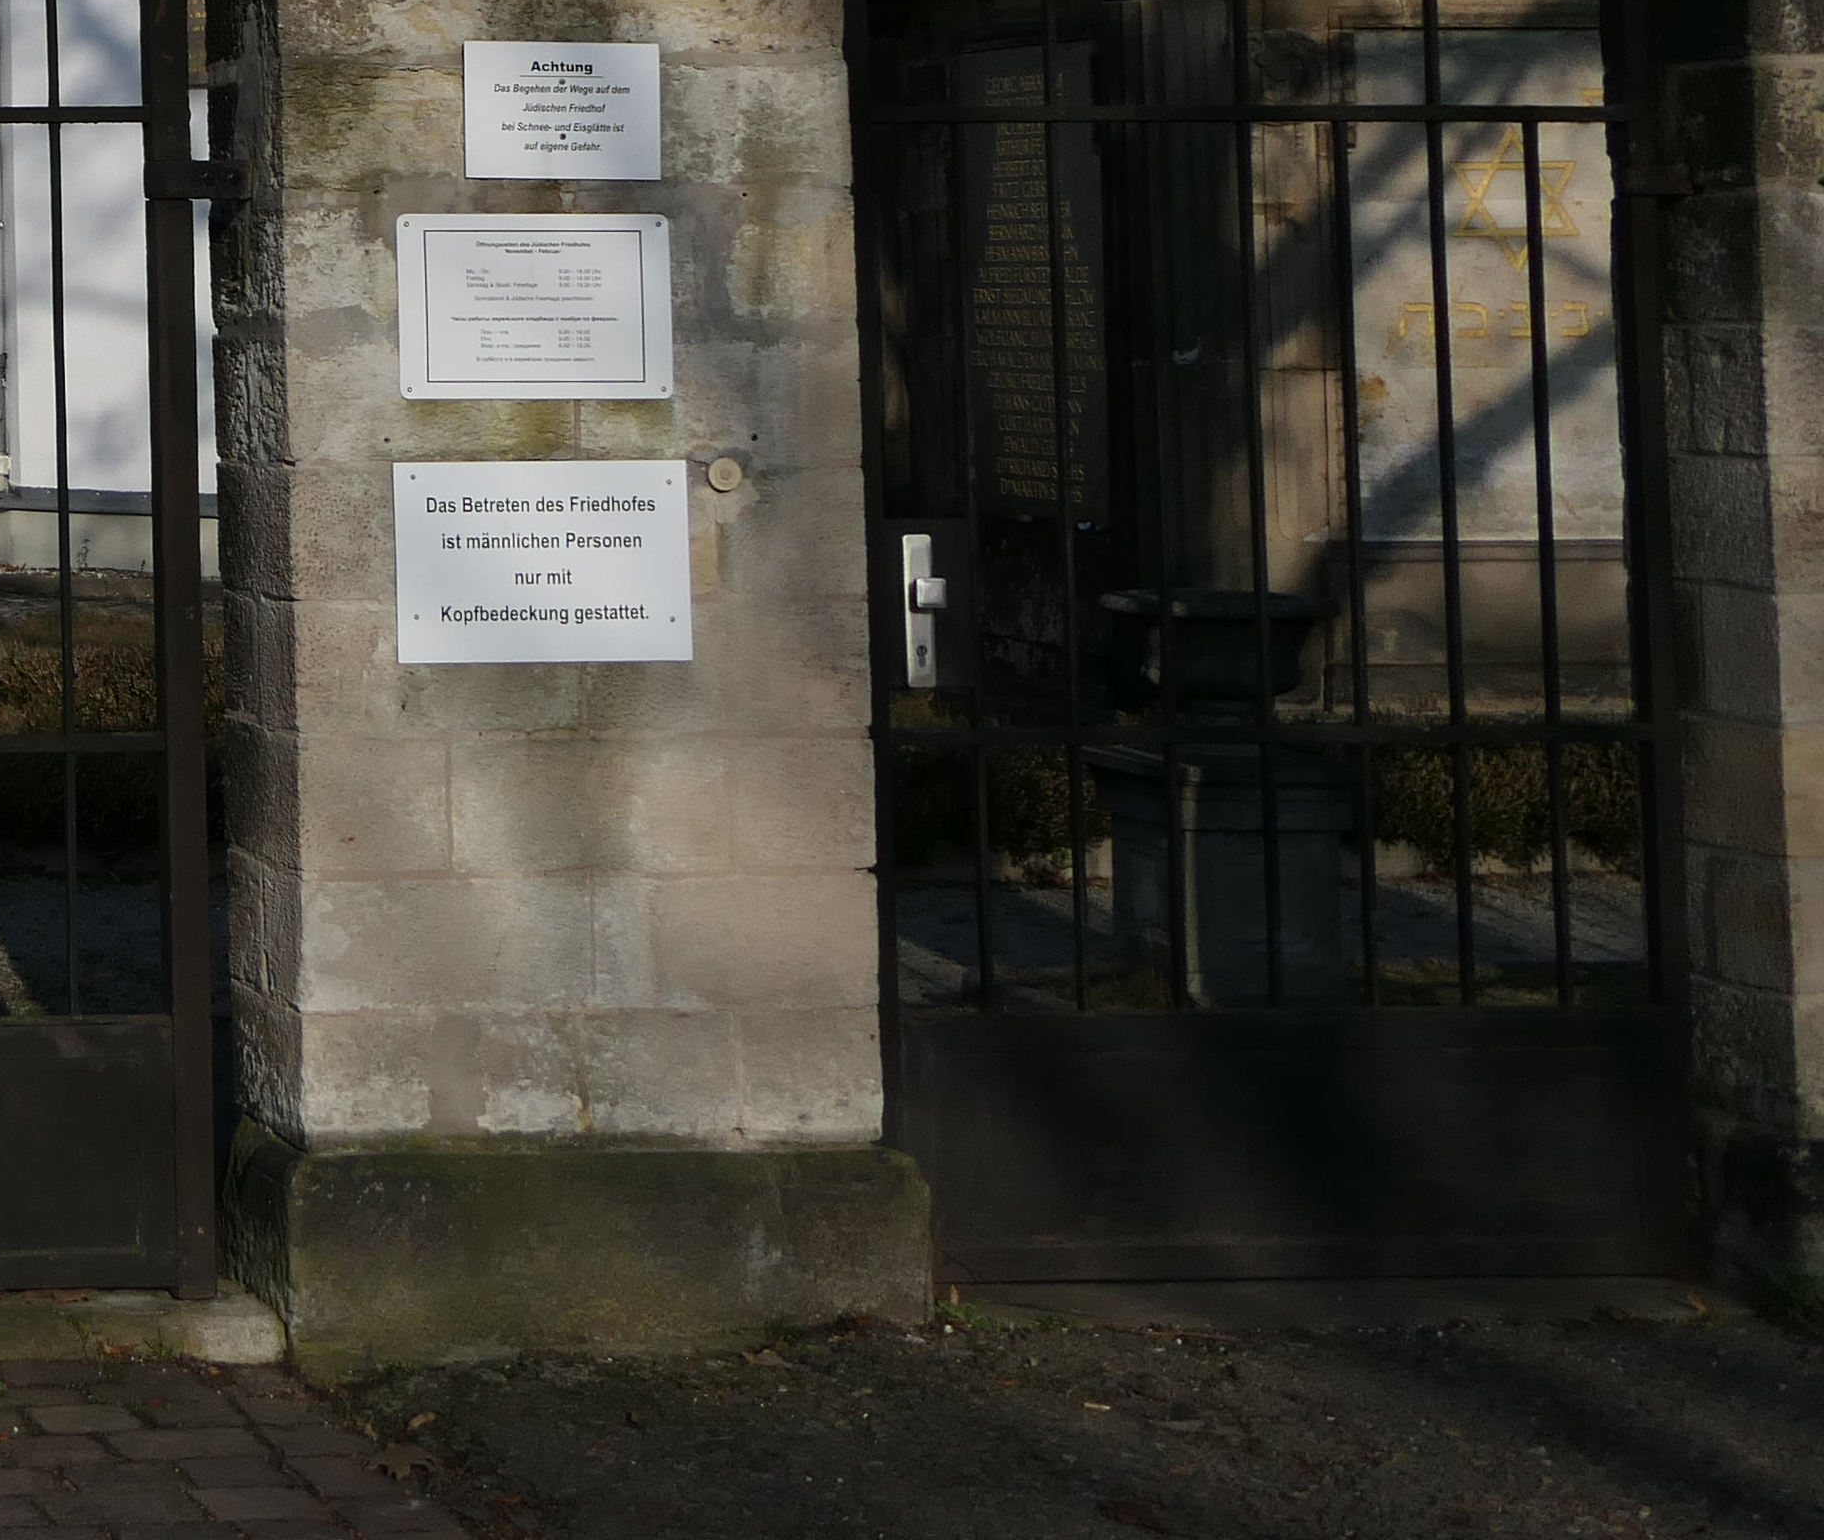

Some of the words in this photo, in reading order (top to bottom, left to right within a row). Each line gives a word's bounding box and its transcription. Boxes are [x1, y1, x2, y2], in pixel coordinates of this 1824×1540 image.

[531, 61, 593, 74] Achtung
[494, 84, 510, 93] Das
[513, 84, 550, 95] Begehen
[553, 85, 567, 93] der
[570, 85, 593, 95] Wege
[595, 85, 610, 93] auf
[613, 85, 630, 94] dem
[523, 103, 566, 113] Jüdischen
[569, 104, 606, 113] Friedhof
[502, 122, 514, 131] bei
[517, 122, 551, 131] Schnee-
[555, 123, 571, 131] und
[574, 123, 610, 134] Eisglätte
[613, 123, 624, 132] ist
[524, 142, 538, 150] auf
[540, 142, 568, 152] eigene
[571, 142, 602, 151] Gefahr.
[425, 495, 456, 514] Das
[462, 495, 530, 514] Betreten
[535, 494, 564, 513] des
[569, 493, 655, 514] Friedhofes
[441, 533, 461, 550] ist
[465, 531, 560, 551] männlichen
[565, 531, 642, 549] Personen
[514, 571, 541, 586] nur
[546, 568, 572, 586] mit
[440, 603, 570, 626] Kopfbedeckung
[574, 603, 649, 625] gestattet.
